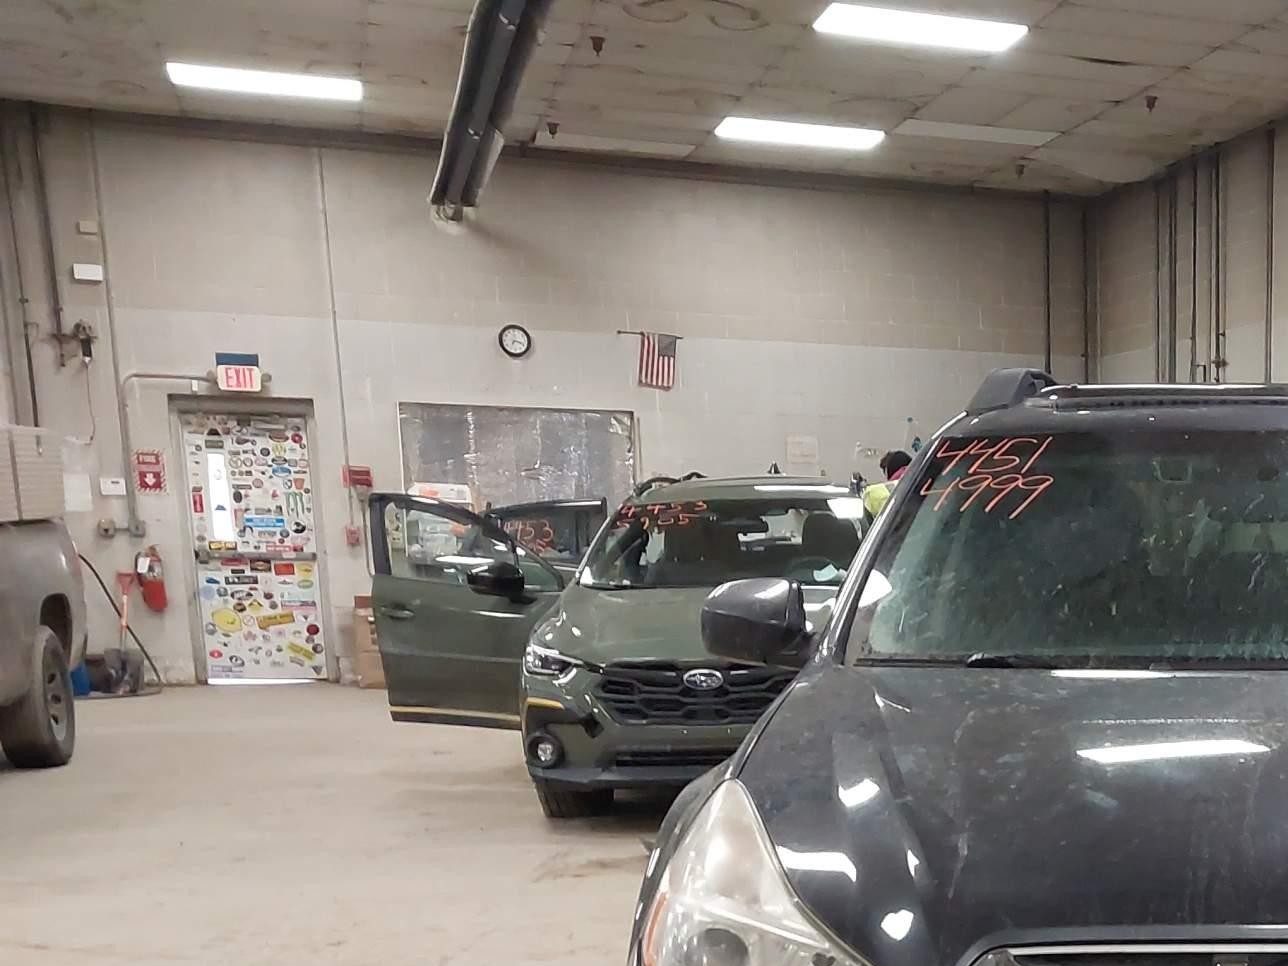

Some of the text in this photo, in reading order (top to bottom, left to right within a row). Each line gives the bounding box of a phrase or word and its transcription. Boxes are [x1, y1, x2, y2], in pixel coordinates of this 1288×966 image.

[224, 367, 255, 389] EXIT
[936, 436, 1053, 475] 4451
[920, 474, 1054, 520] 4999
